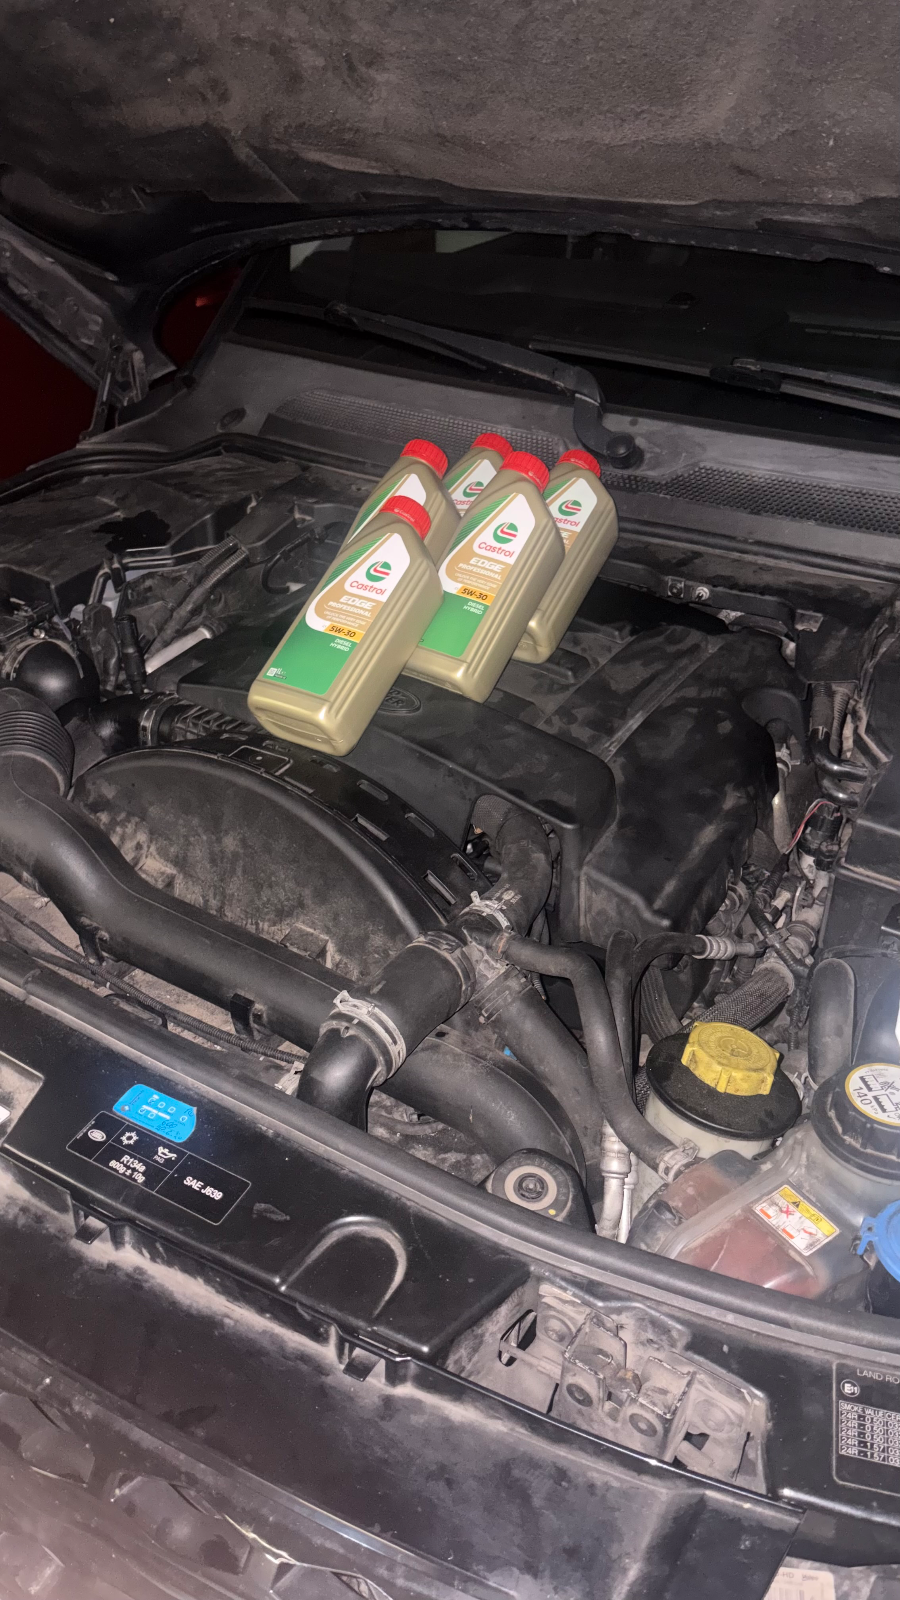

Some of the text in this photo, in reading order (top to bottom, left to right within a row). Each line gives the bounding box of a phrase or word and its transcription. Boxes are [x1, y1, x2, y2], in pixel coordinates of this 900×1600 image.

[554, 517, 581, 527] astrol
[478, 541, 515, 558] Castrol
[469, 557, 506, 572] EDGE
[457, 562, 502, 580] PROFESSIONAL
[349, 580, 387, 596] Castrol
[461, 588, 488, 601] 5W-30
[339, 595, 377, 610] EDGE
[467, 601, 485, 611] DIESEL
[327, 601, 372, 617] PROFESSIONAL
[462, 605, 483, 615] HYBRID
[329, 625, 357, 638] 5W-30
[329, 642, 350, 652] HYBRID
[334, 638, 352, 648] DIESEL
[852, 1086, 873, 1106] 140
[120, 1154, 147, 1173] R134a
[152, 1154, 165, 1164] PAG
[131, 1171, 146, 1183] 10g
[183, 1176, 224, 1201] SAE J639
[856, 1368, 900, 1384] LAND RO
[840, 1402, 885, 1418] SMOKE VALUE
[841, 1410, 858, 1420] 24R
[885, 1412, 900, 1421] CER
[841, 1419, 858, 1429] 24R
[841, 1427, 858, 1437] 24R
[841, 1436, 858, 1446] 24R
[841, 1445, 858, 1456] 24R
